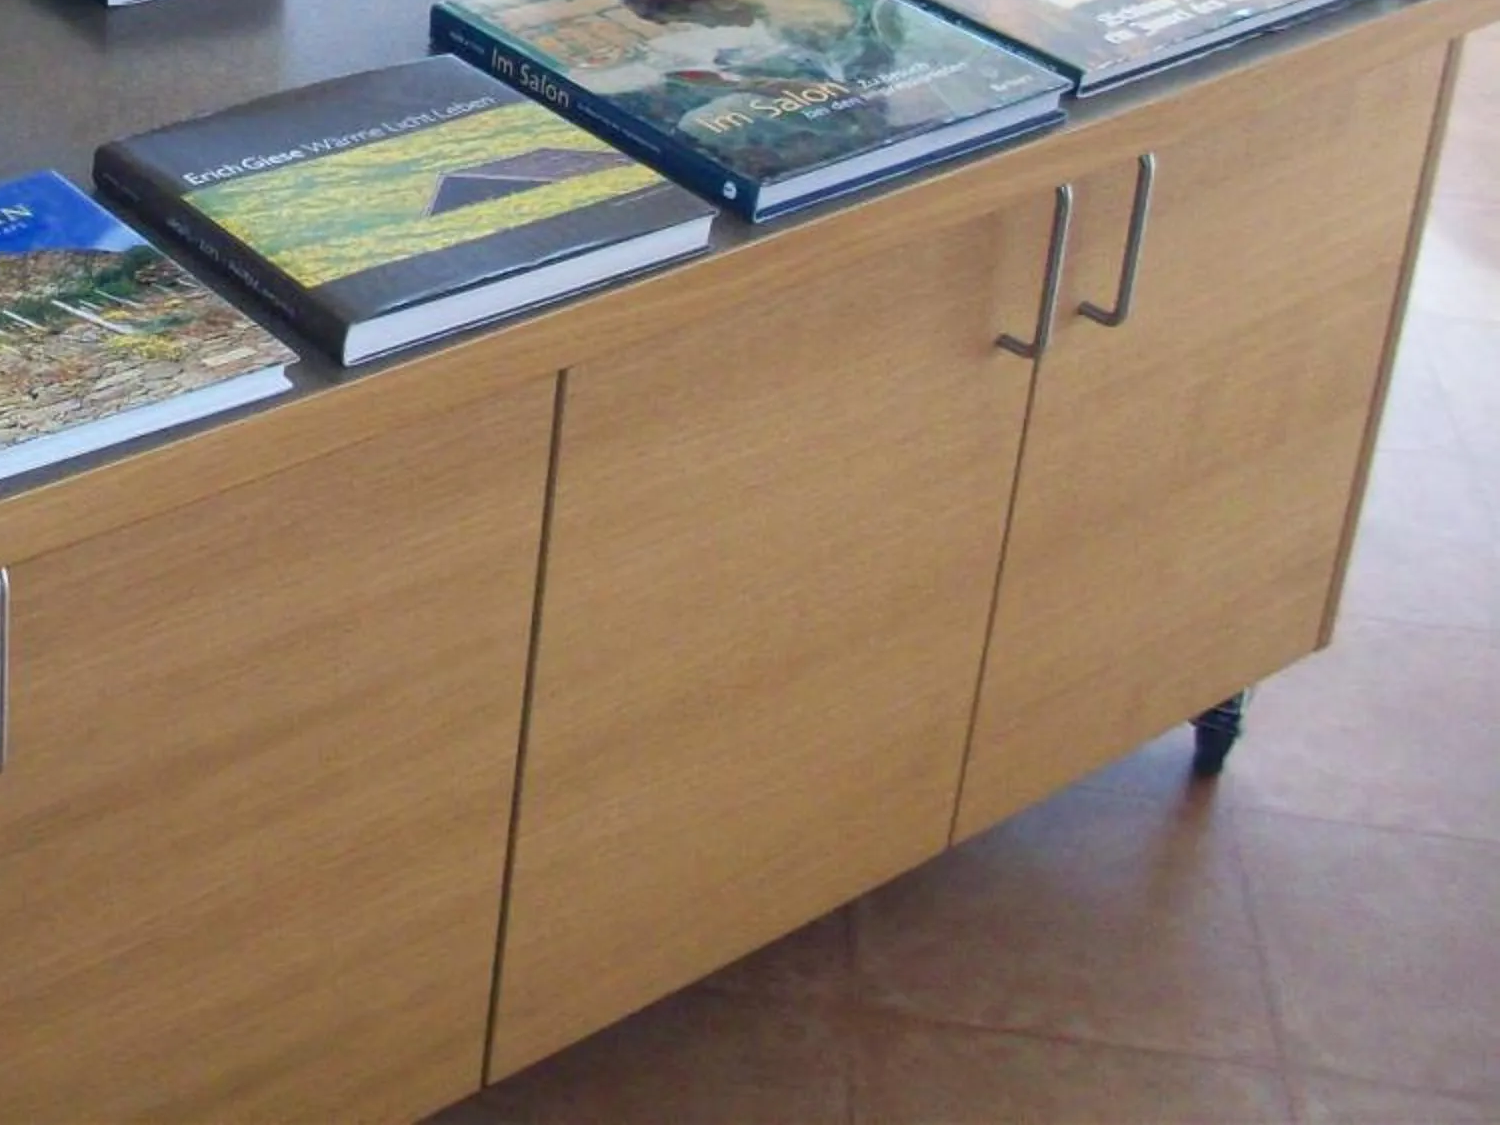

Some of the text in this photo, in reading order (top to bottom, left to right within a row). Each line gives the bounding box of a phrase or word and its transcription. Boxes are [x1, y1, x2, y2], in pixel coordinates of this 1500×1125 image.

[490, 47, 570, 109] Im Salon
[695, 111, 755, 135] Im
[749, 81, 851, 119] Salon
[181, 161, 243, 187] Erich
[241, 148, 304, 171] Giese
[380, 109, 433, 133] Licht
[429, 94, 496, 122] Leben
